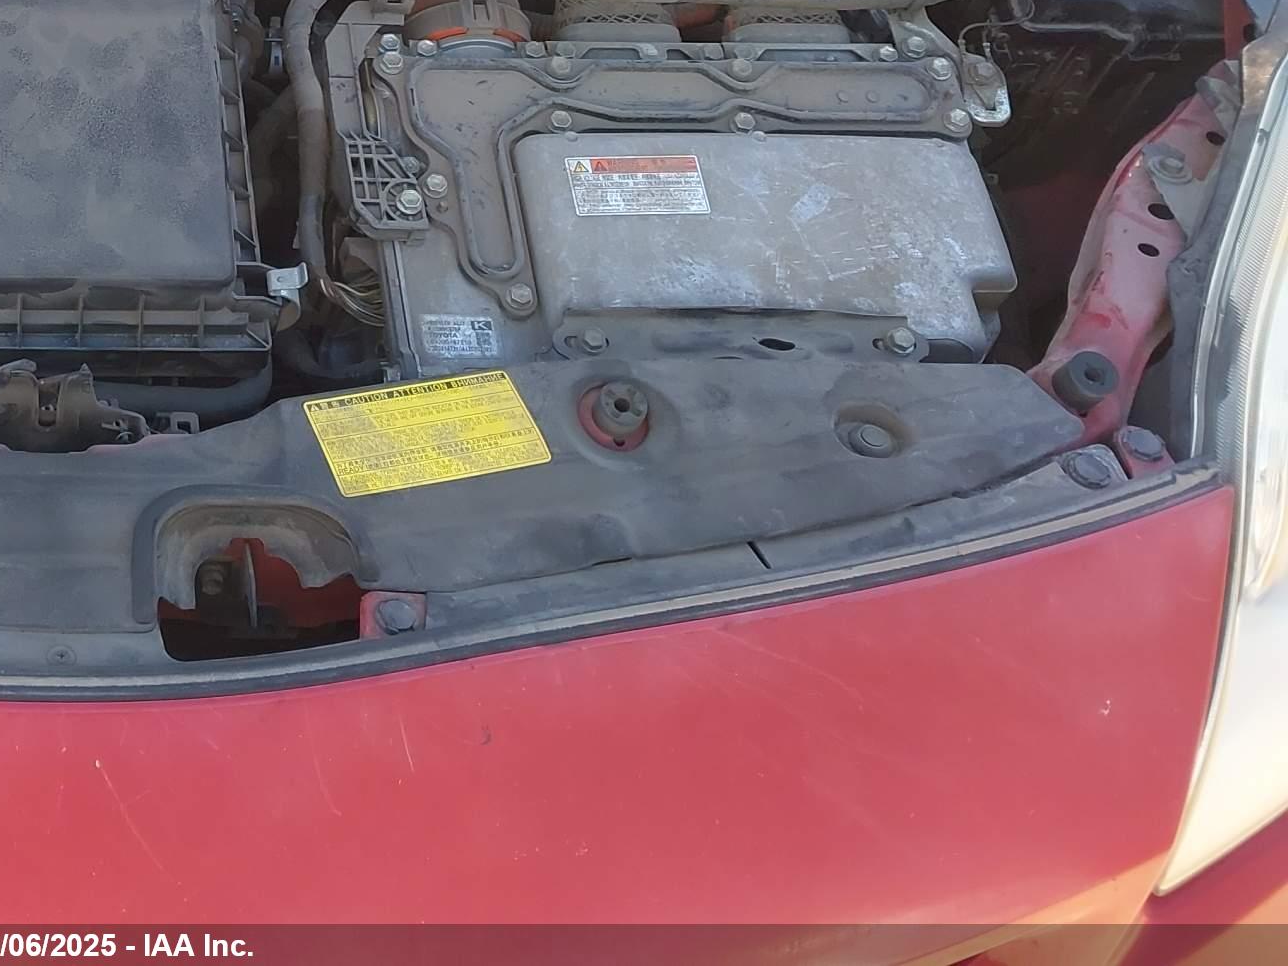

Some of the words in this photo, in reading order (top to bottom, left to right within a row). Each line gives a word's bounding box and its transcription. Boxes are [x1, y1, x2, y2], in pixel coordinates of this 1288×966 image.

[344, 392, 389, 406] CAUTION
[393, 382, 448, 399] ATTENTION
[451, 373, 504, 389] ВНИМАНИЕ
